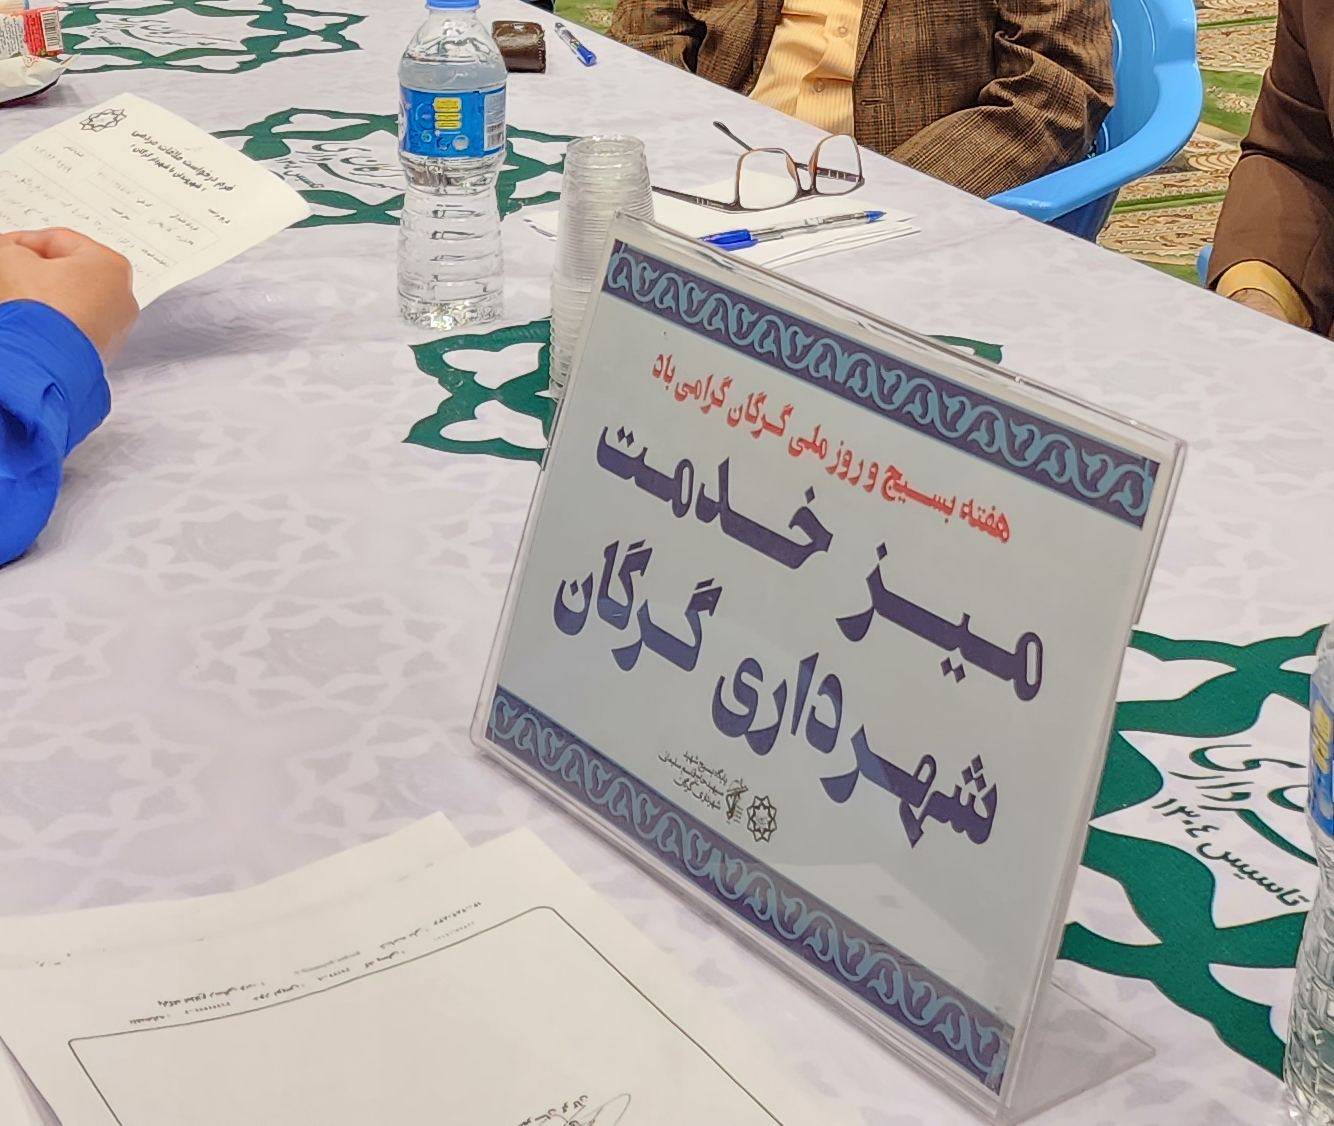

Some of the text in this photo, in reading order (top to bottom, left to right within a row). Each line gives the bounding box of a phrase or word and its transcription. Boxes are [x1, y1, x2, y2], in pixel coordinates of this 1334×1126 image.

[596, 425, 1043, 702] میز خدمت
[652, 353, 1011, 544] هفته بسیج و روز ملی گرگان گرامی باد
[553, 538, 998, 849] شهرداری گرگان
[1195, 842, 1311, 907] تاسیس
